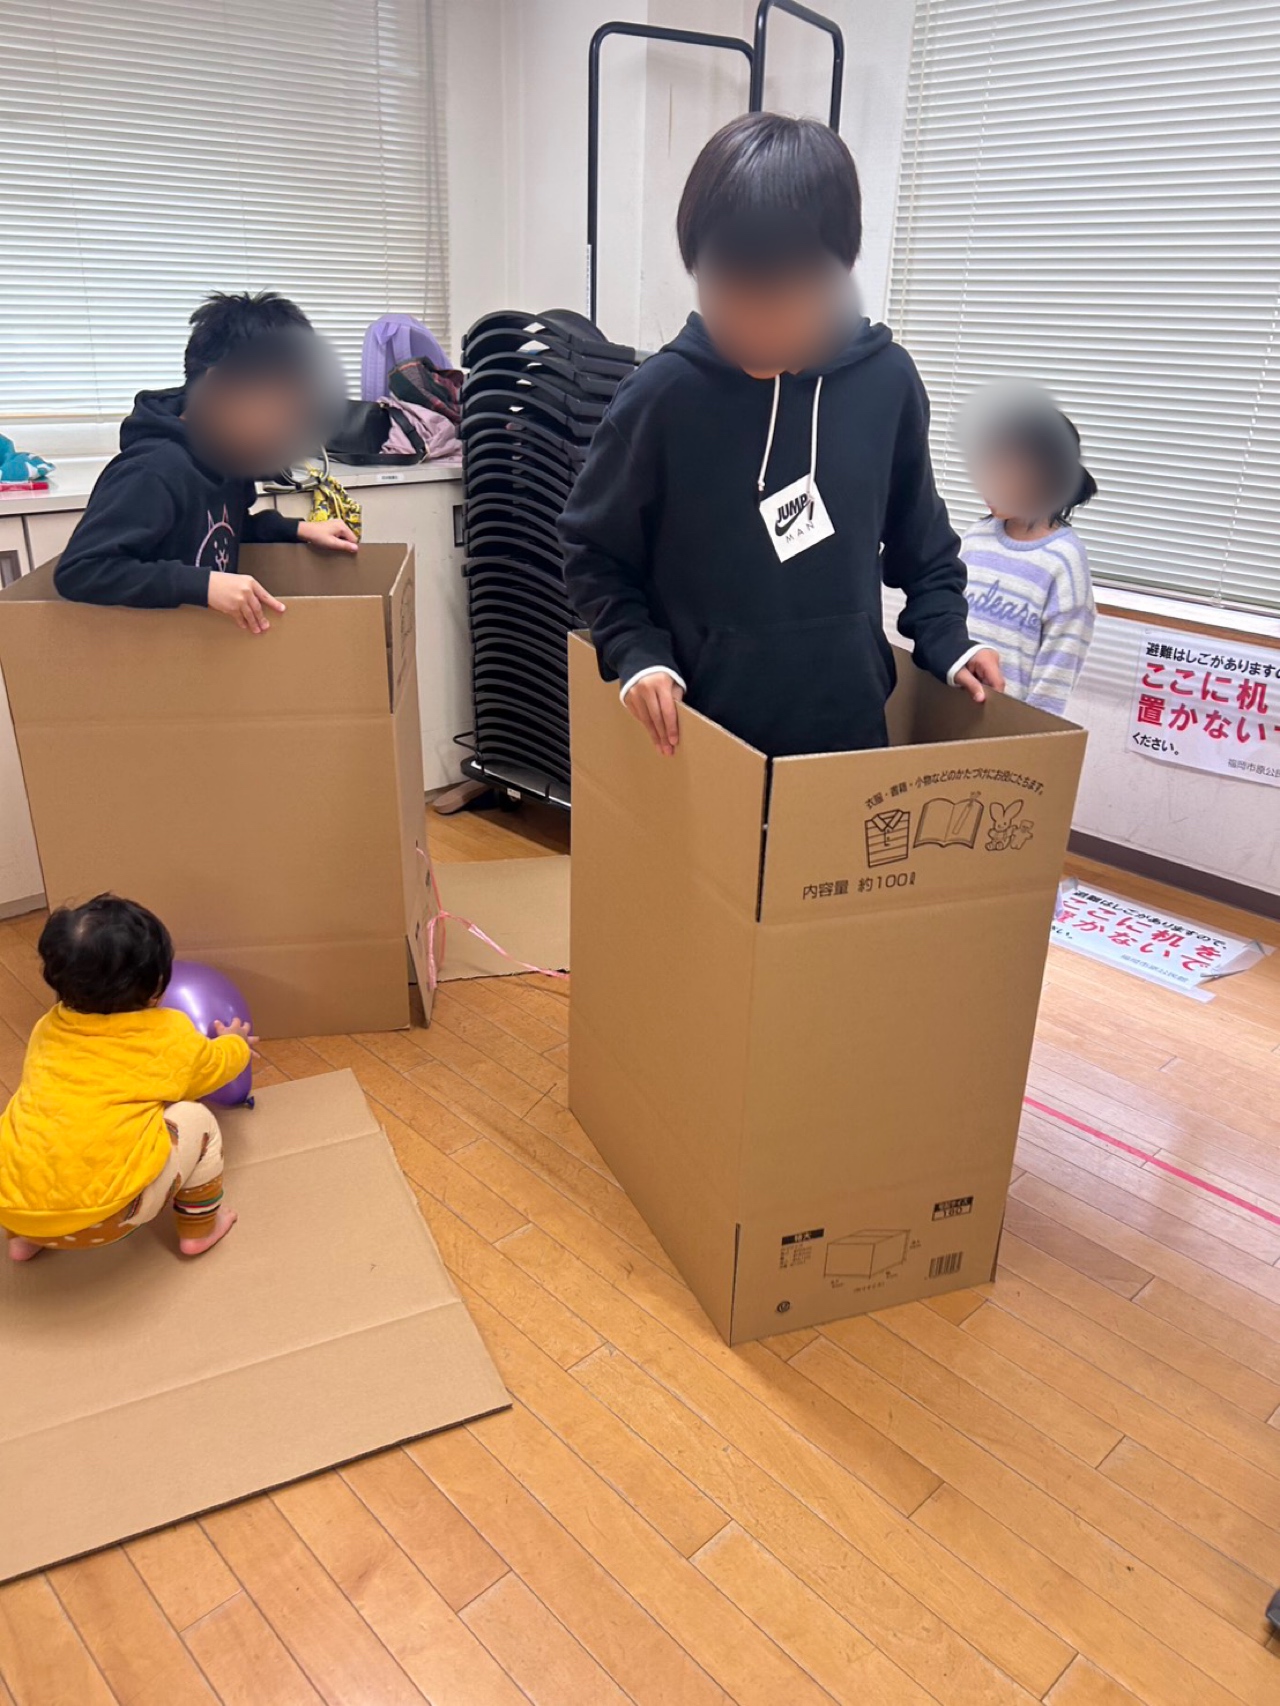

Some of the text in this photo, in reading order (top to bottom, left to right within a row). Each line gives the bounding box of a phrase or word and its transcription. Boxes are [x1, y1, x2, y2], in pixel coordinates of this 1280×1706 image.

[777, 493, 808, 523] JUMP
[785, 522, 815, 543] MAN
[1142, 662, 1268, 714] ここに机
[803, 880, 848, 899] 内容量
